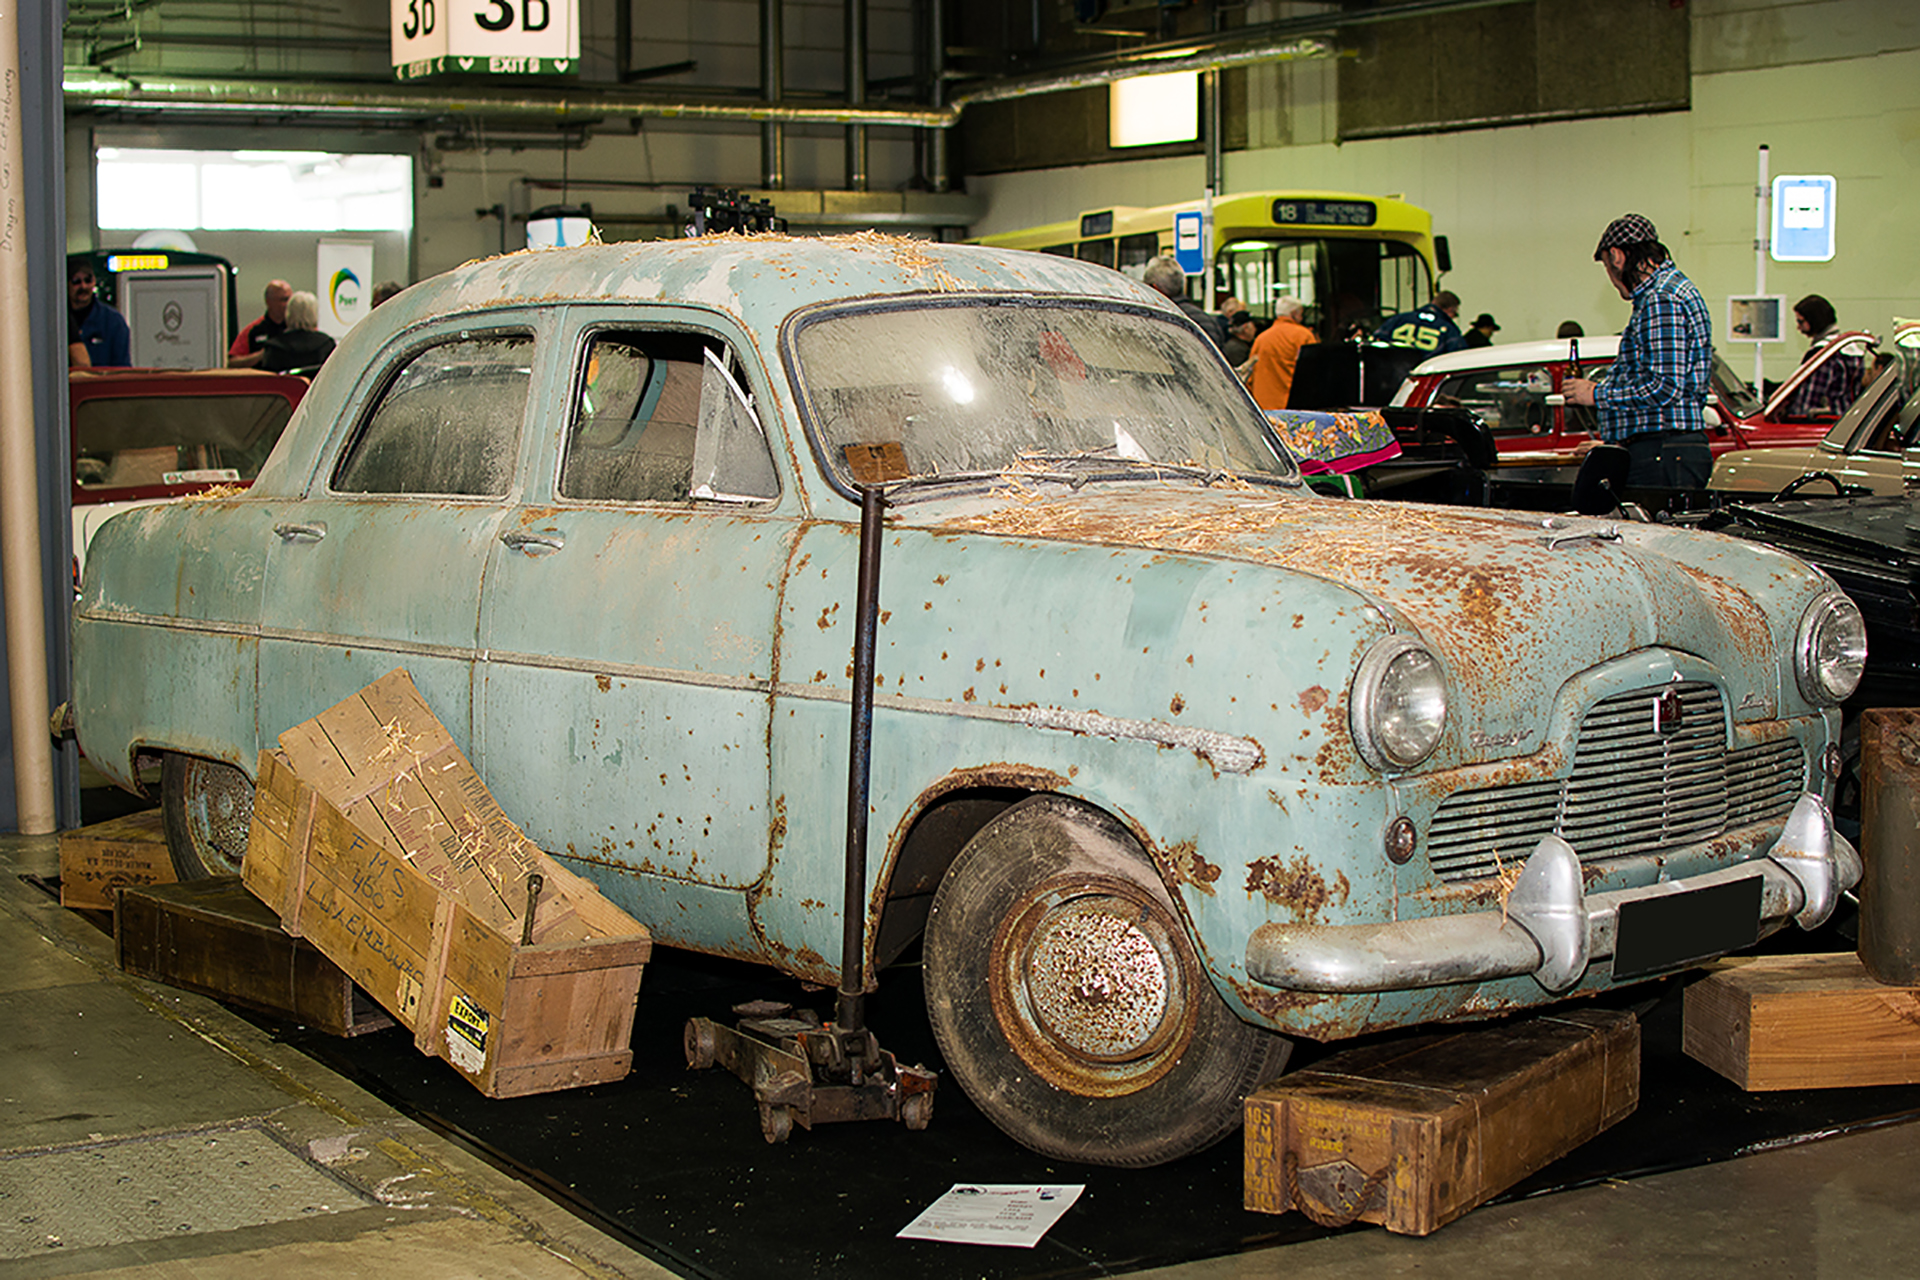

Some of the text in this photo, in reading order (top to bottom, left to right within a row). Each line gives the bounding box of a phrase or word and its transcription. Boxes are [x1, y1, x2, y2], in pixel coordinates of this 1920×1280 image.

[489, 57, 526, 73] EXIT
[1278, 204, 1297, 221] 18
[1392, 323, 1440, 351] 45
[1247, 1106, 1271, 1125] 105
